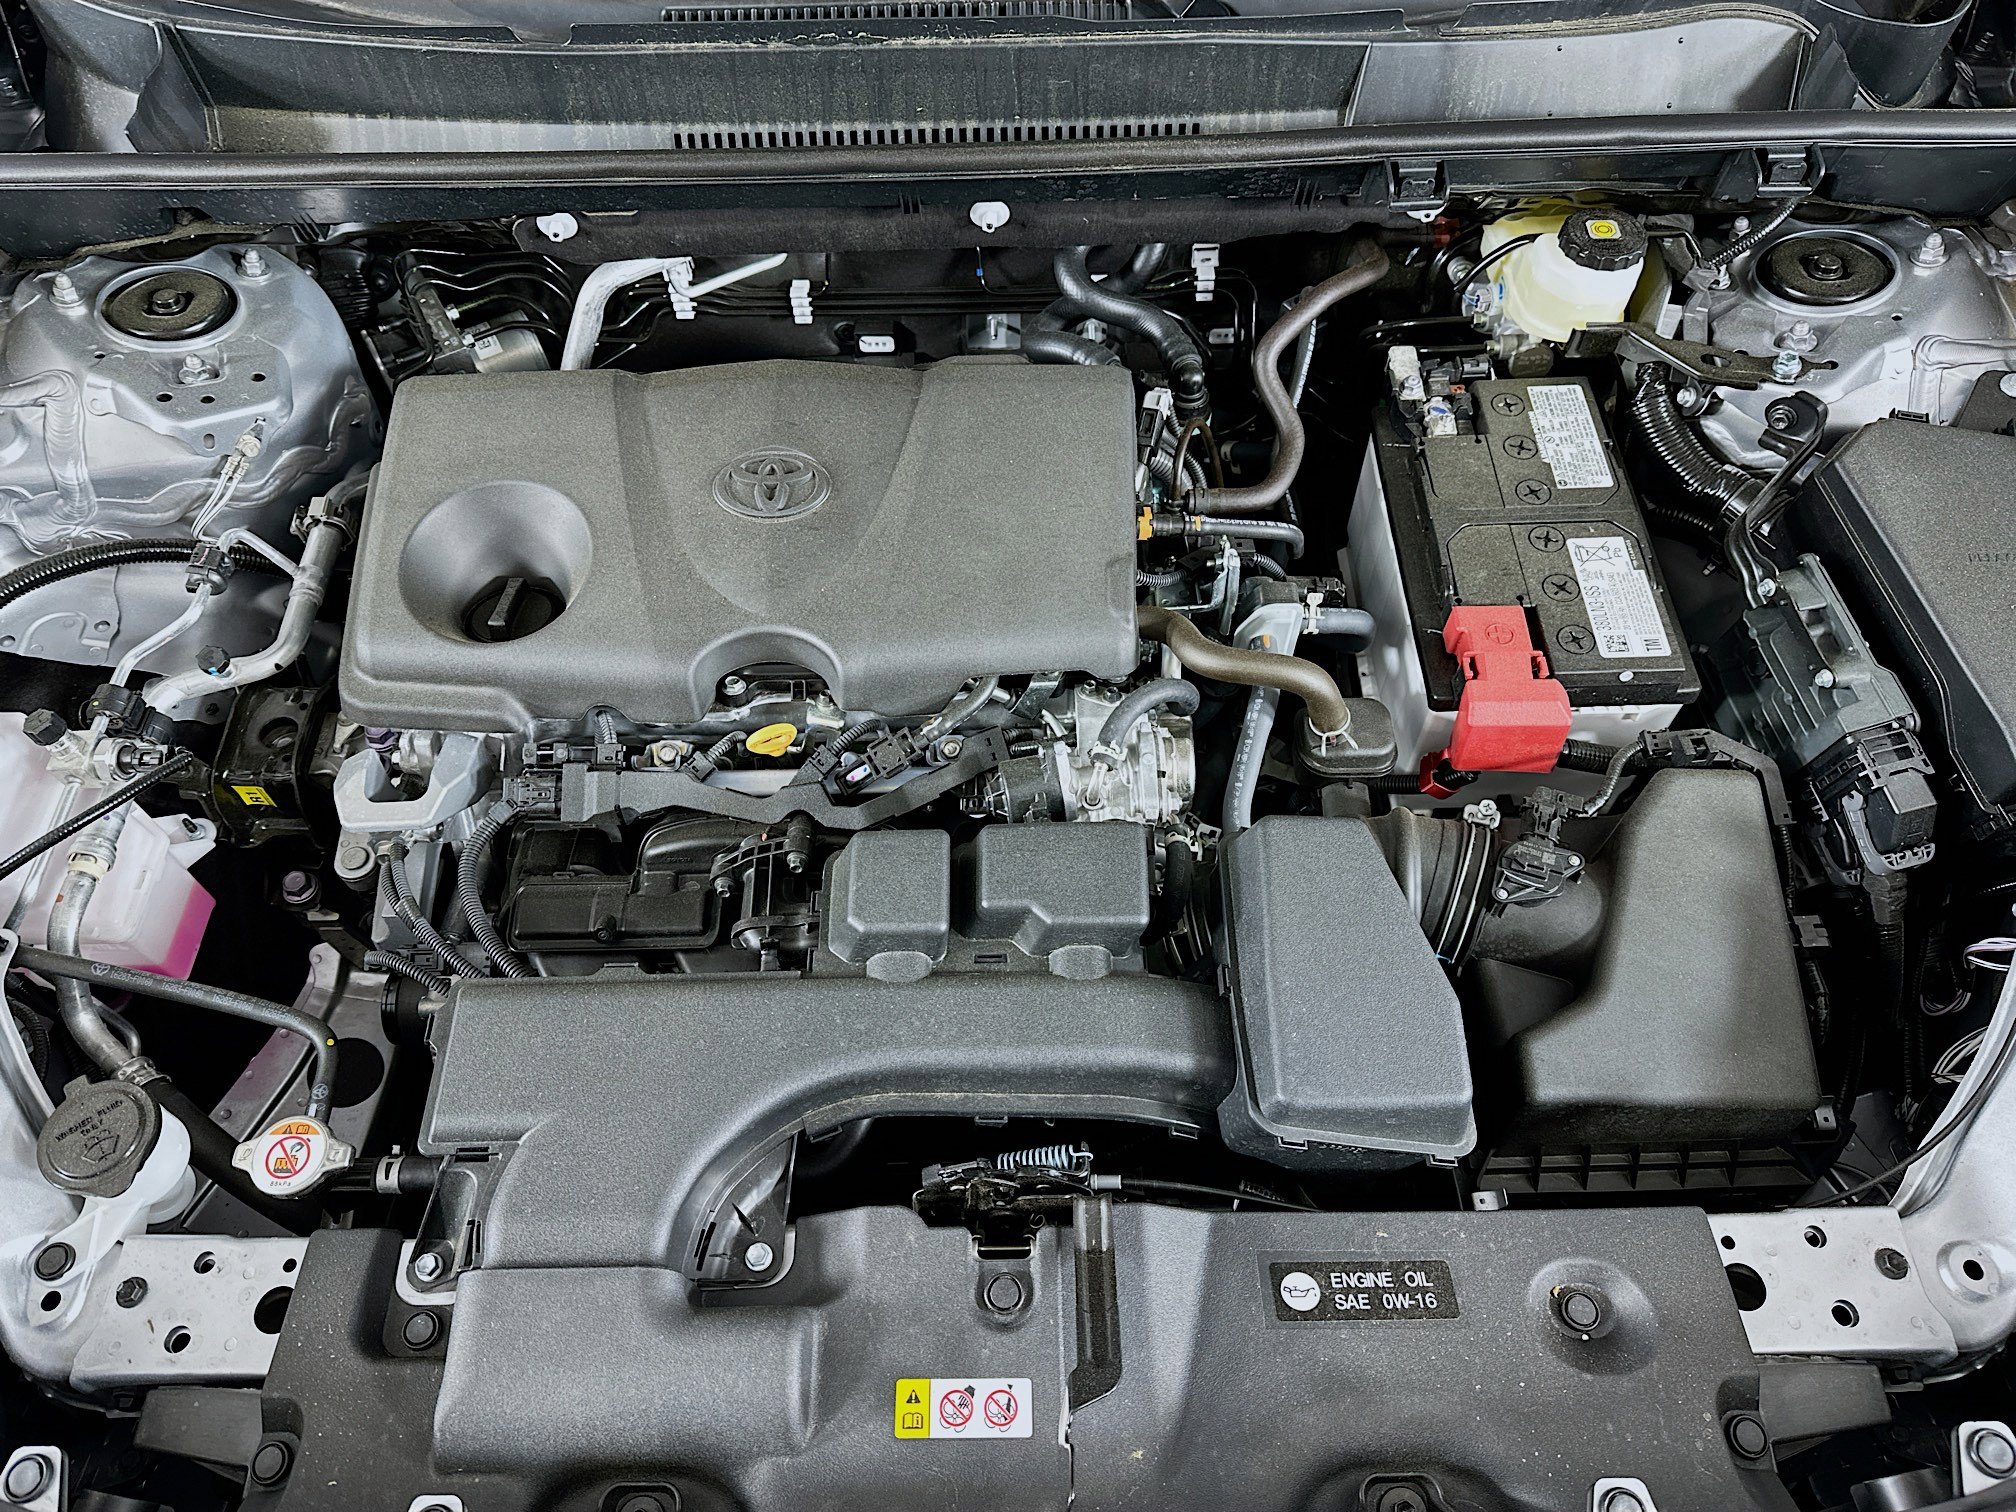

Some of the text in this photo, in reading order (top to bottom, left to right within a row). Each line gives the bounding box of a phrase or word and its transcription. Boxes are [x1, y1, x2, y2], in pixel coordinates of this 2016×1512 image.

[1643, 638, 1663, 652] TM
[1329, 1271, 1434, 1289] ENGINE OIL
[1334, 1292, 1438, 1310] SAE 0W-16
